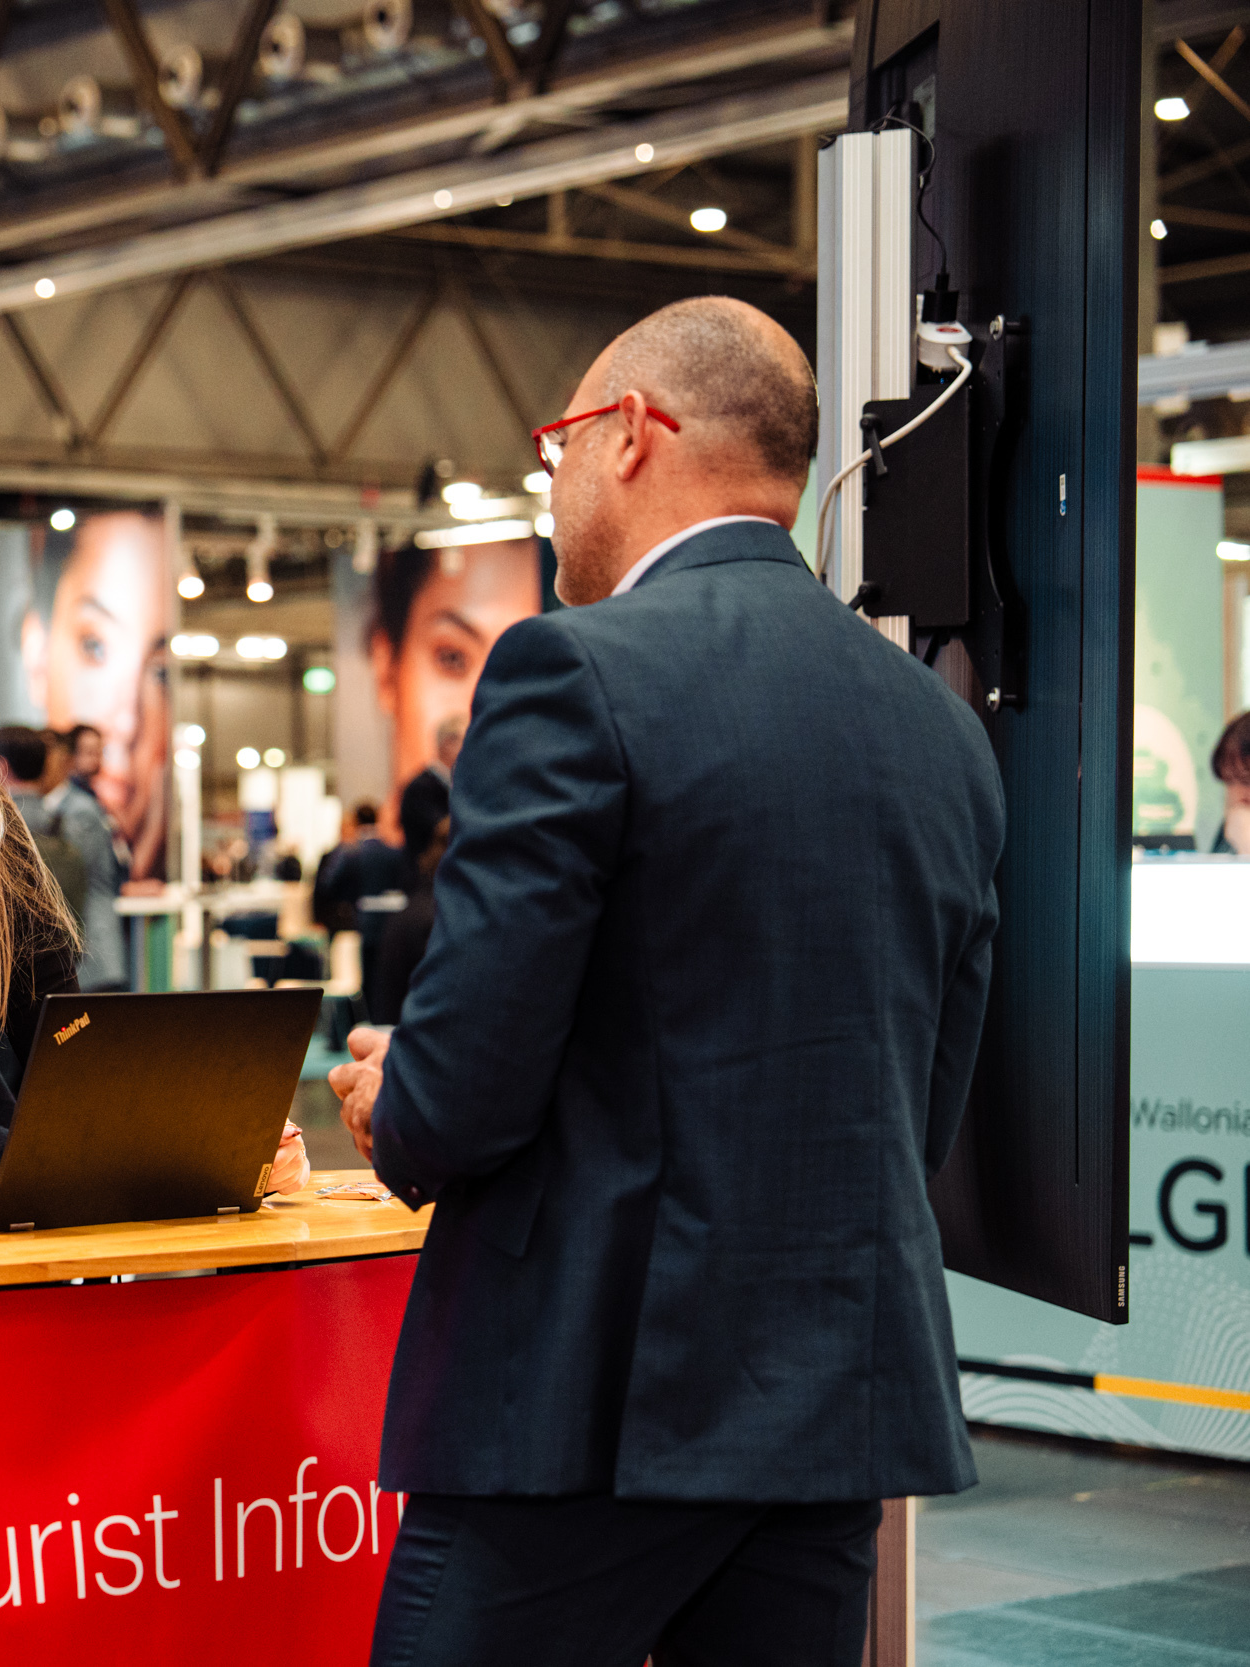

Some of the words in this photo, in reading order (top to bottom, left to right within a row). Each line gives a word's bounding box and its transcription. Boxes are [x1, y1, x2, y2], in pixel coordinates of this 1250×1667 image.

[52, 1011, 90, 1046] ThinkPad
[256, 1166, 269, 1194] Lenovo
[1117, 1265, 1126, 1307] SAMSUNG
[214, 1456, 405, 1581] Infor
